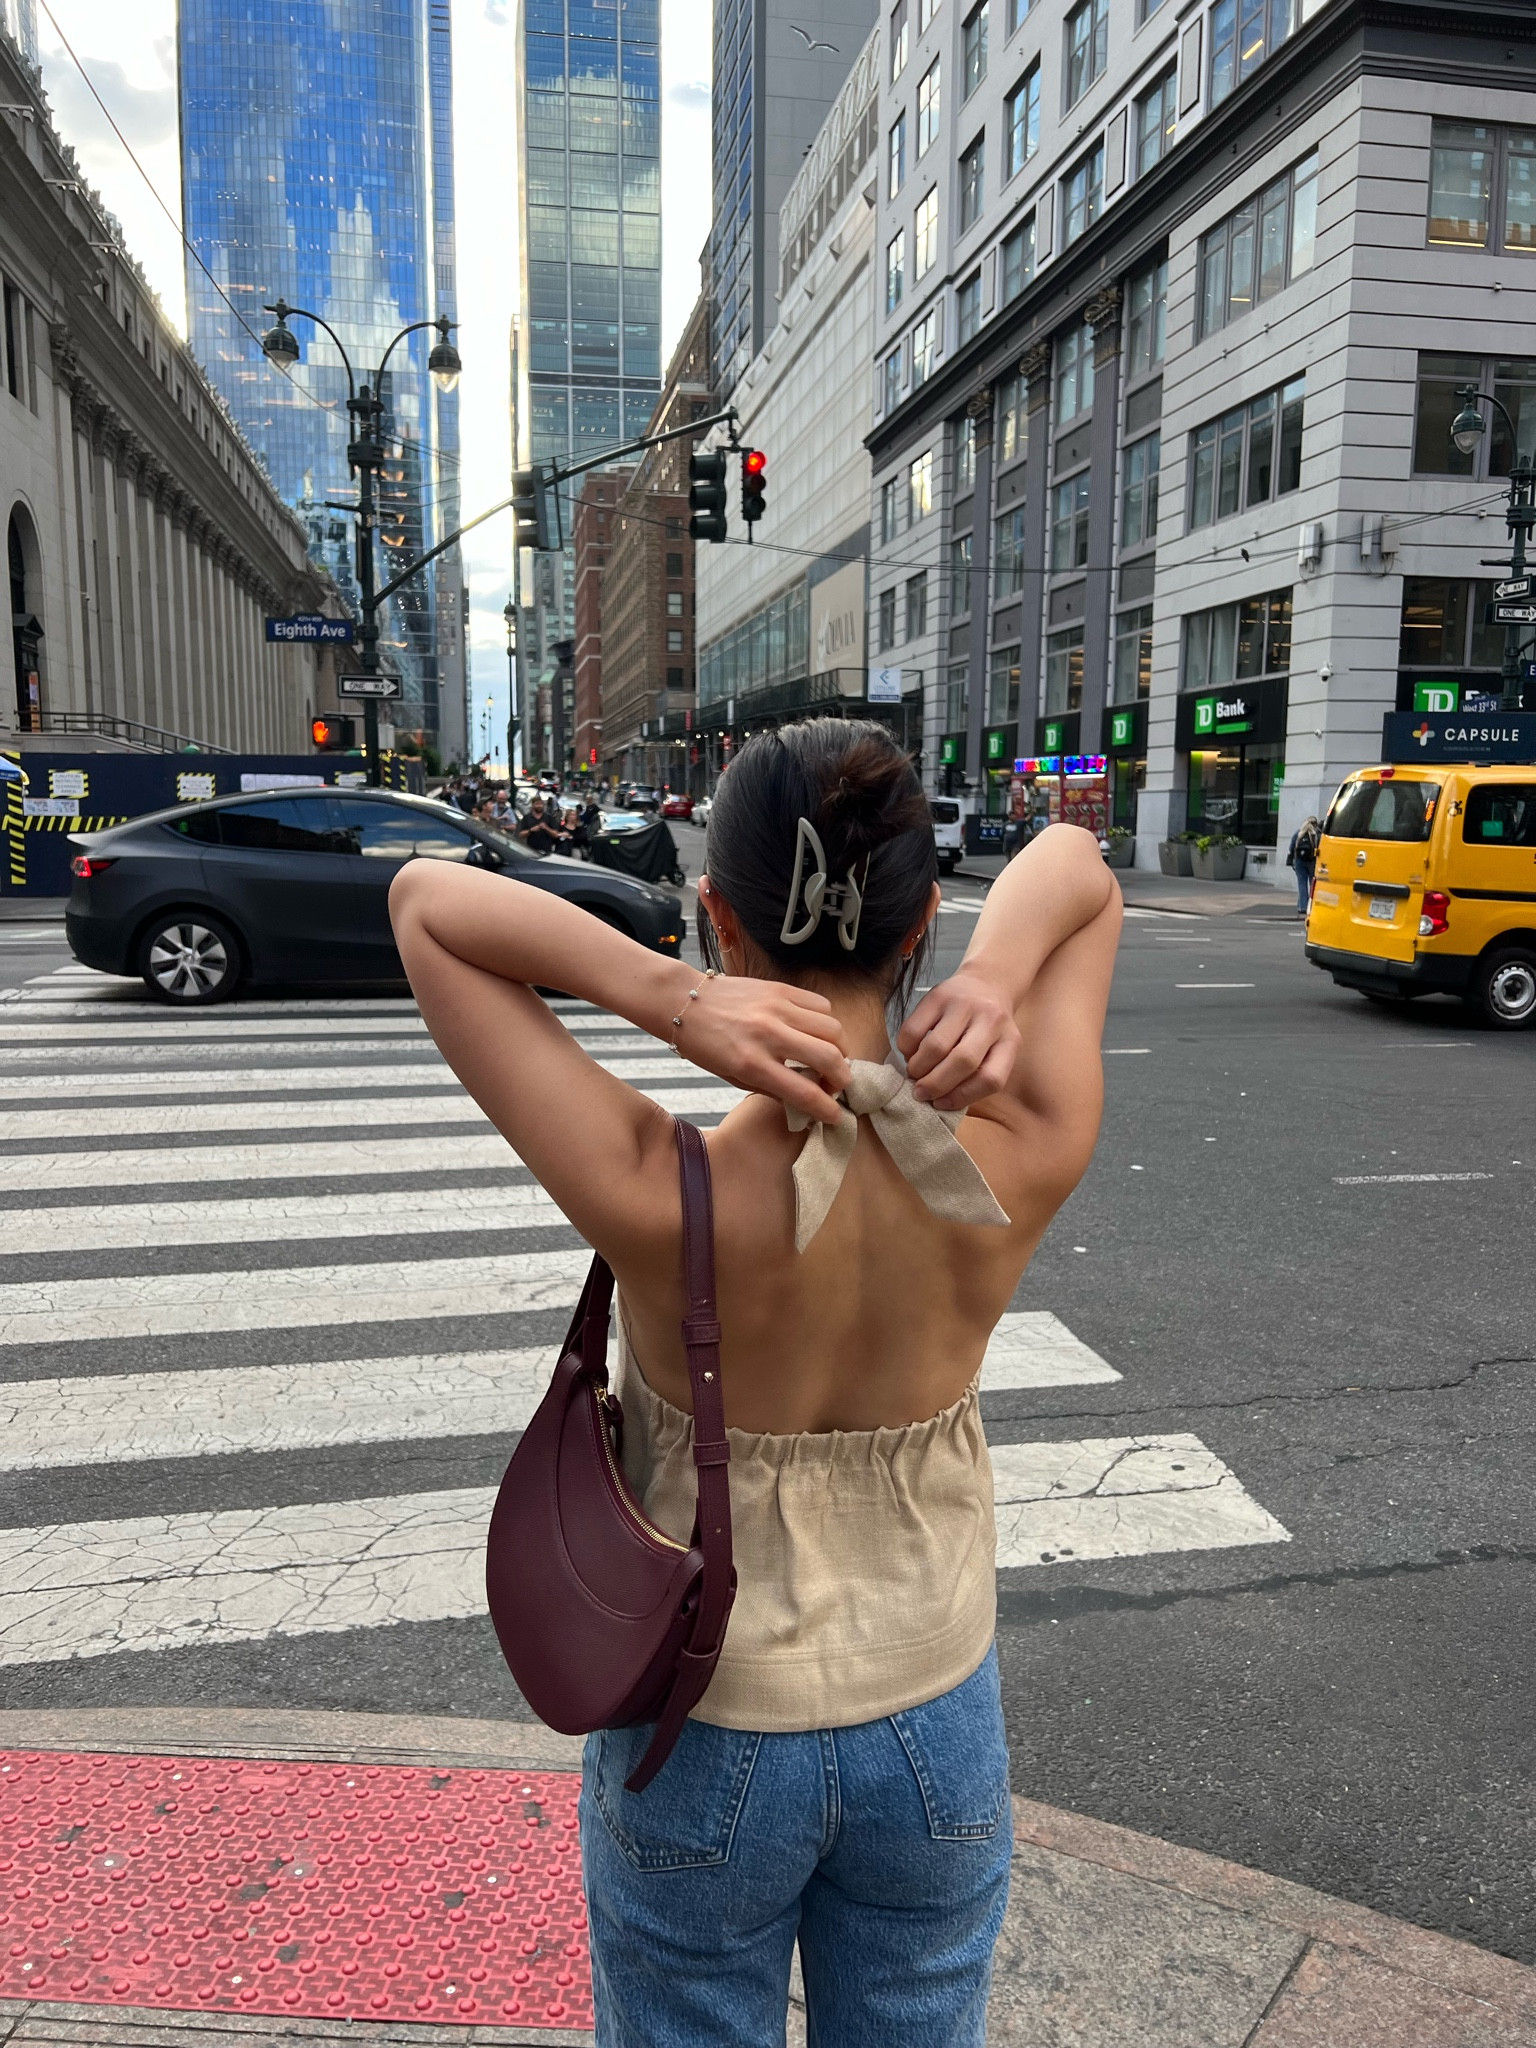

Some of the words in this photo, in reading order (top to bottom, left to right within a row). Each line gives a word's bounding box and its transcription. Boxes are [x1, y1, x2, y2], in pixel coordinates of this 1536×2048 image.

[1499, 586, 1509, 594] ONE
[1503, 609, 1515, 617] ONE
[274, 622, 317, 639] Eighth
[320, 624, 346, 637] Ave
[349, 681, 366, 691] ONE
[374, 681, 391, 690] WAY
[1422, 689, 1454, 712] TD
[1489, 700, 1497, 712] St
[1197, 704, 1212, 727] TD
[1216, 698, 1245, 718] Bank
[1113, 720, 1127, 739] TD
[1444, 728, 1520, 742] CAPSULE
[989, 738, 999, 754] TD
[1046, 730, 1057, 746] TD
